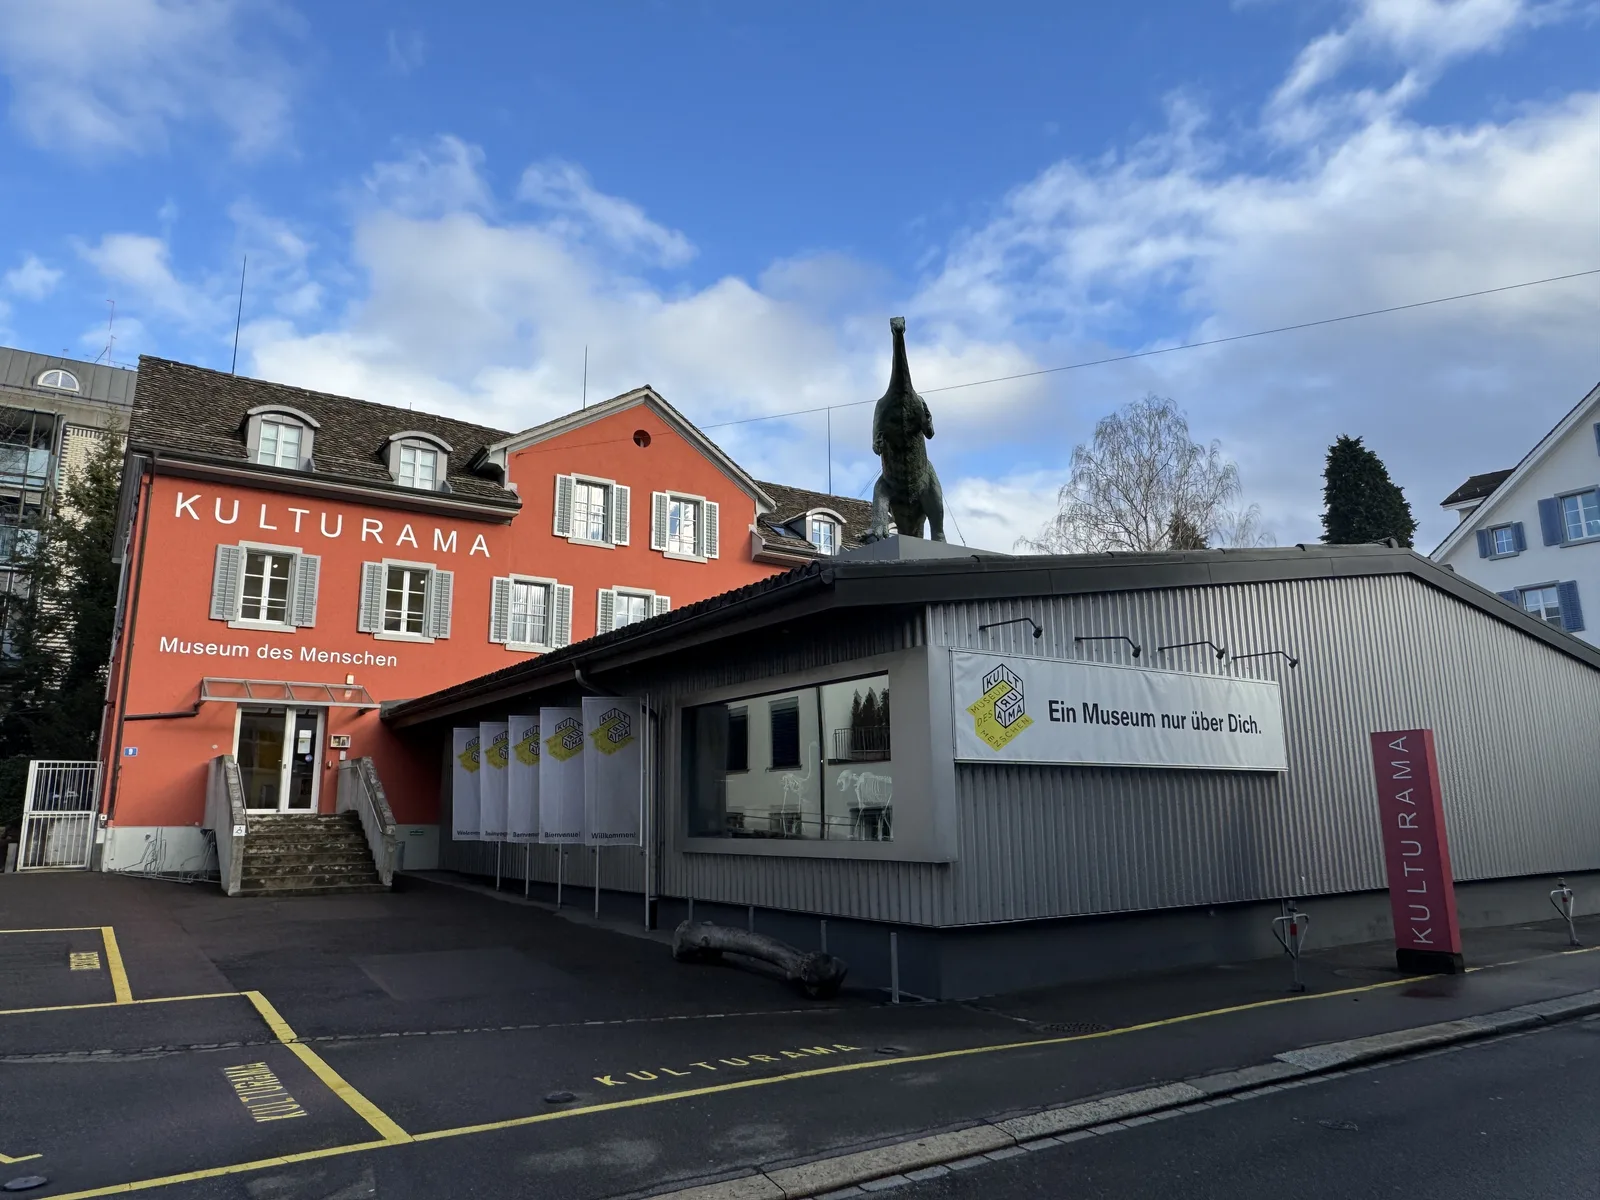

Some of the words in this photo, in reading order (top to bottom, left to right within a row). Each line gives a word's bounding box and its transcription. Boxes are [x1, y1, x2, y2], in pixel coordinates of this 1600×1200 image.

[174, 491, 491, 558] KULTURAMA
[159, 636, 249, 658] Museum
[256, 643, 293, 661] des
[300, 646, 397, 667] Menschen
[977, 709, 993, 727] DES
[1048, 699, 1077, 723] Ein
[1082, 702, 1156, 728] Museum
[1161, 712, 1187, 730] nur
[1191, 711, 1224, 732] über
[1228, 713, 1262, 735] Dich.
[591, 831, 637, 840] Willkommen!
[1388, 735, 1434, 944] KULTURAMA
[592, 1043, 862, 1086] KULTURAMA
